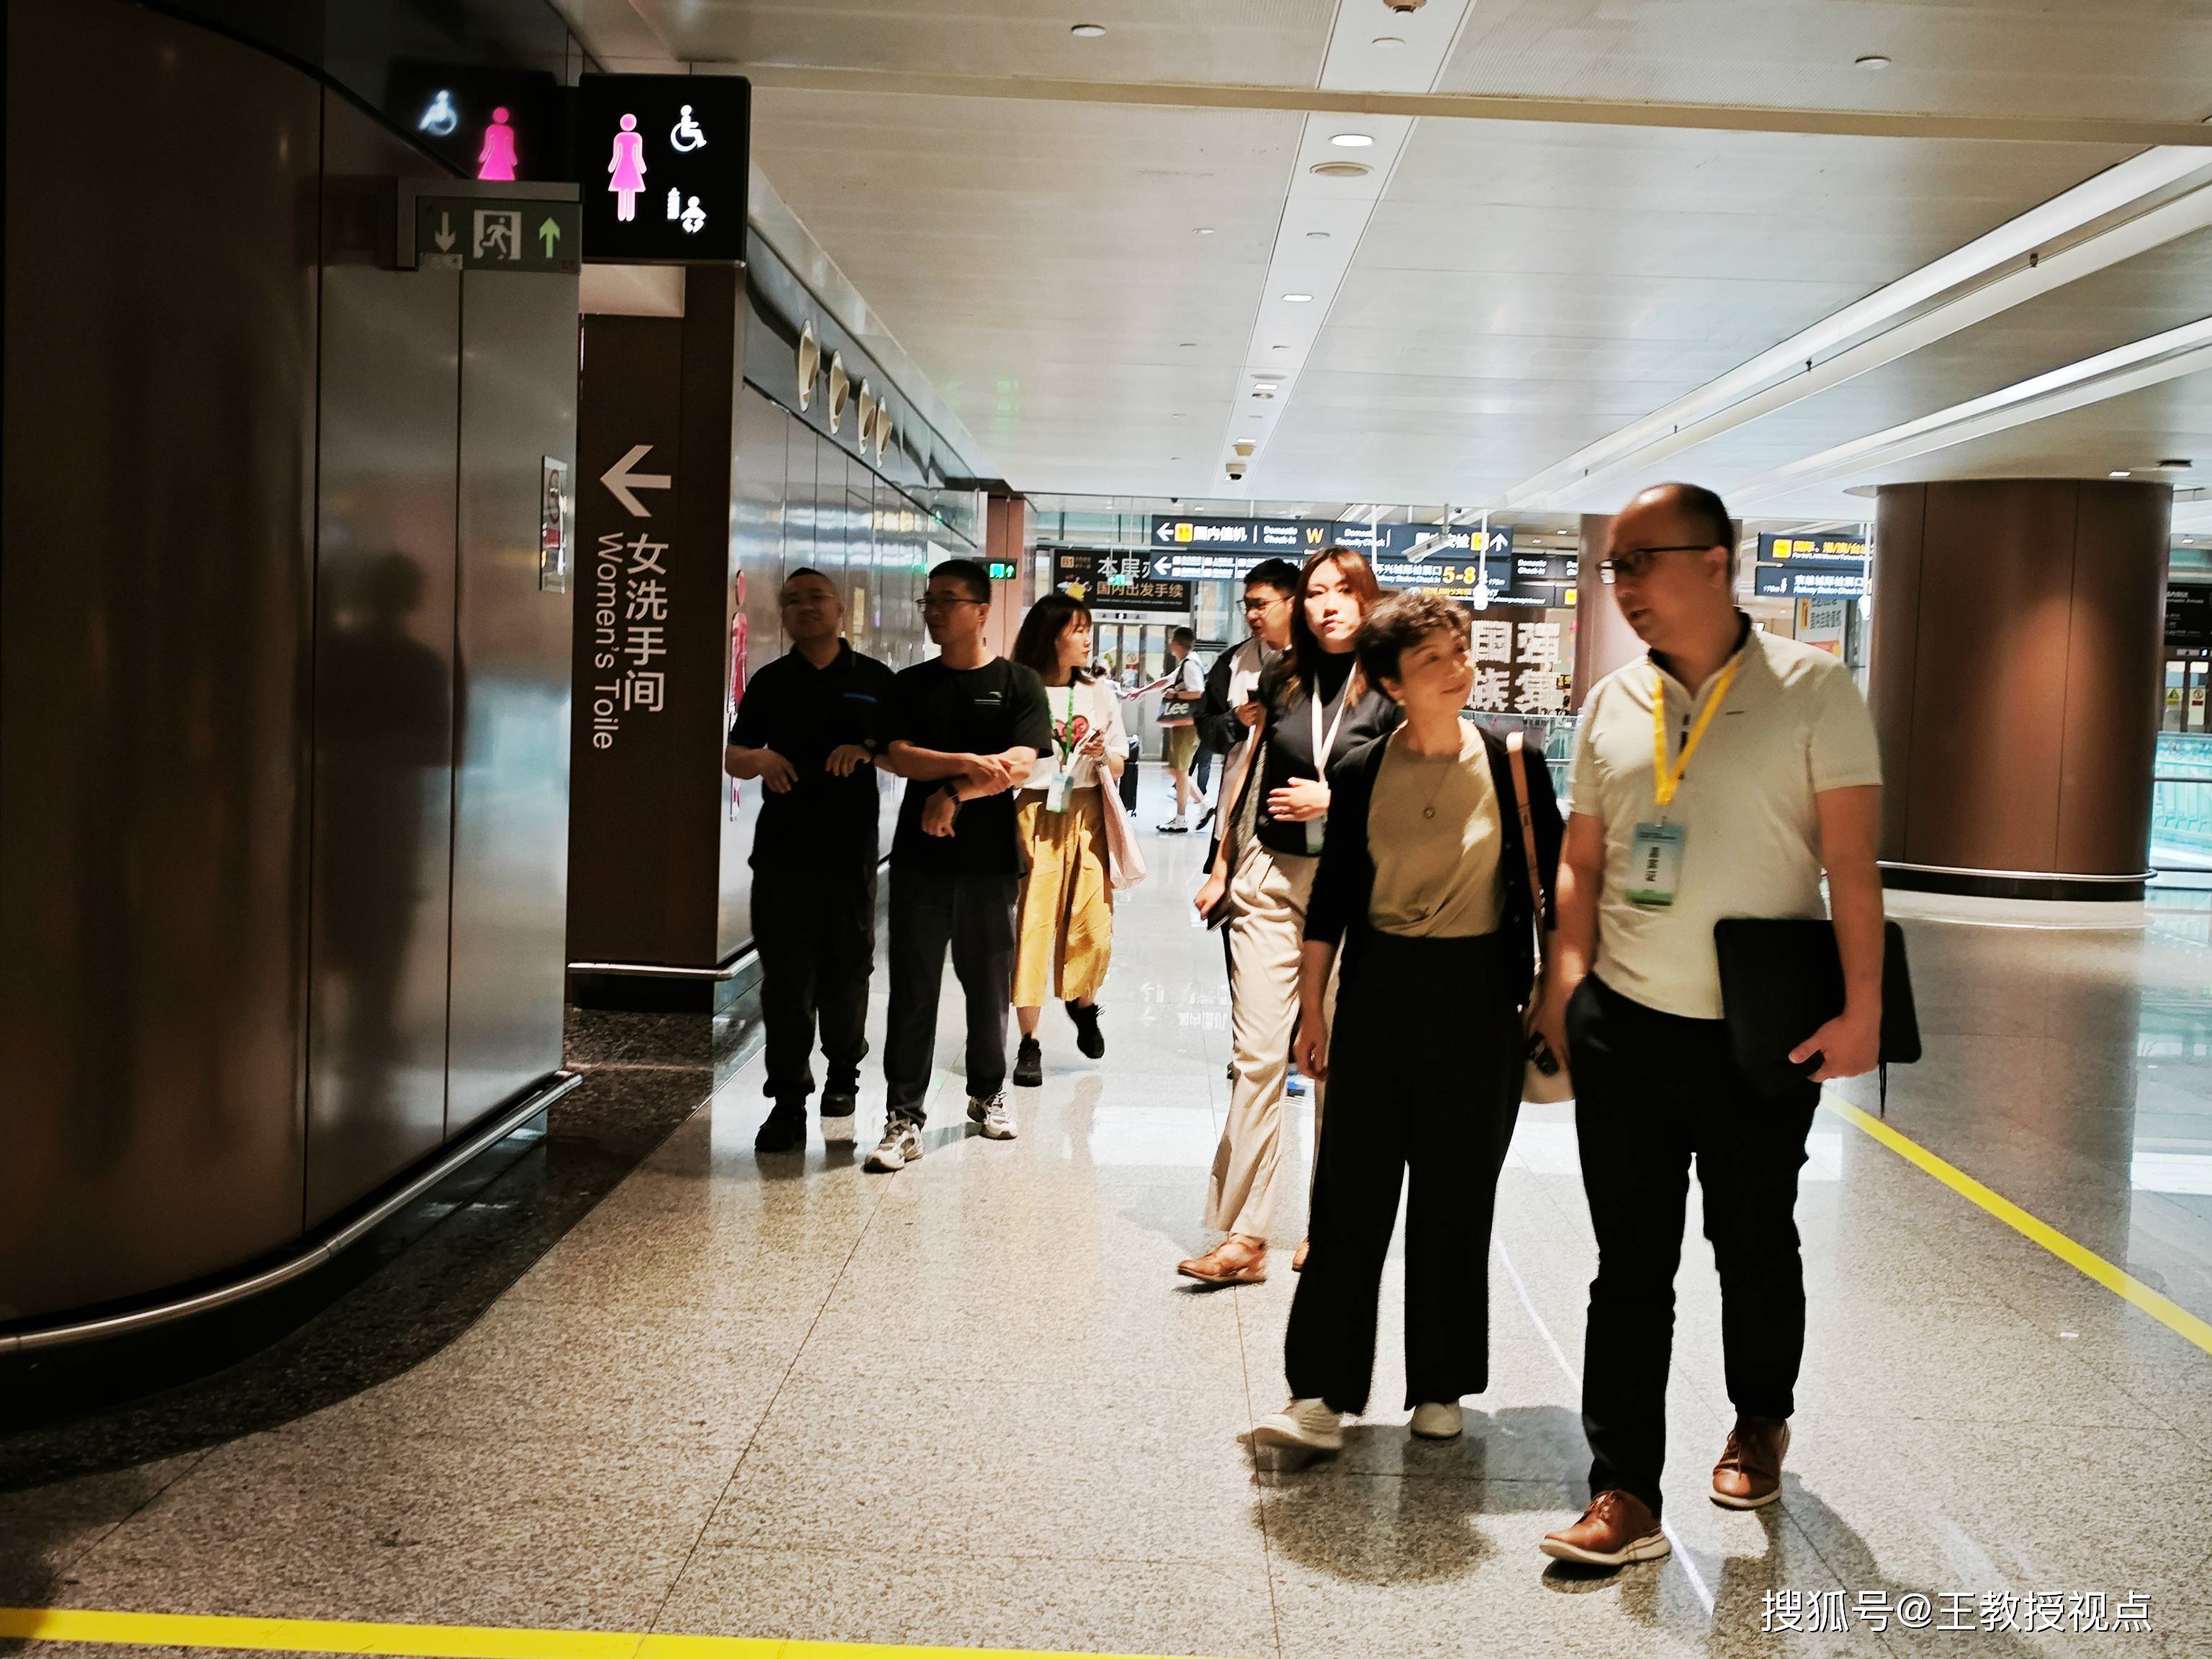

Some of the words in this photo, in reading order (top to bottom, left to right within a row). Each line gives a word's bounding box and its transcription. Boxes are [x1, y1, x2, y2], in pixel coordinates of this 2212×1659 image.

[1305, 527, 1324, 544] W
[1442, 566, 1476, 584] 5-8
[1097, 581, 1184, 598] 国内出发手续
[594, 531, 624, 670] Women's
[624, 533, 669, 713] 女洗手间
[593, 678, 621, 750] Toile
[1164, 702, 1190, 716] Lee
